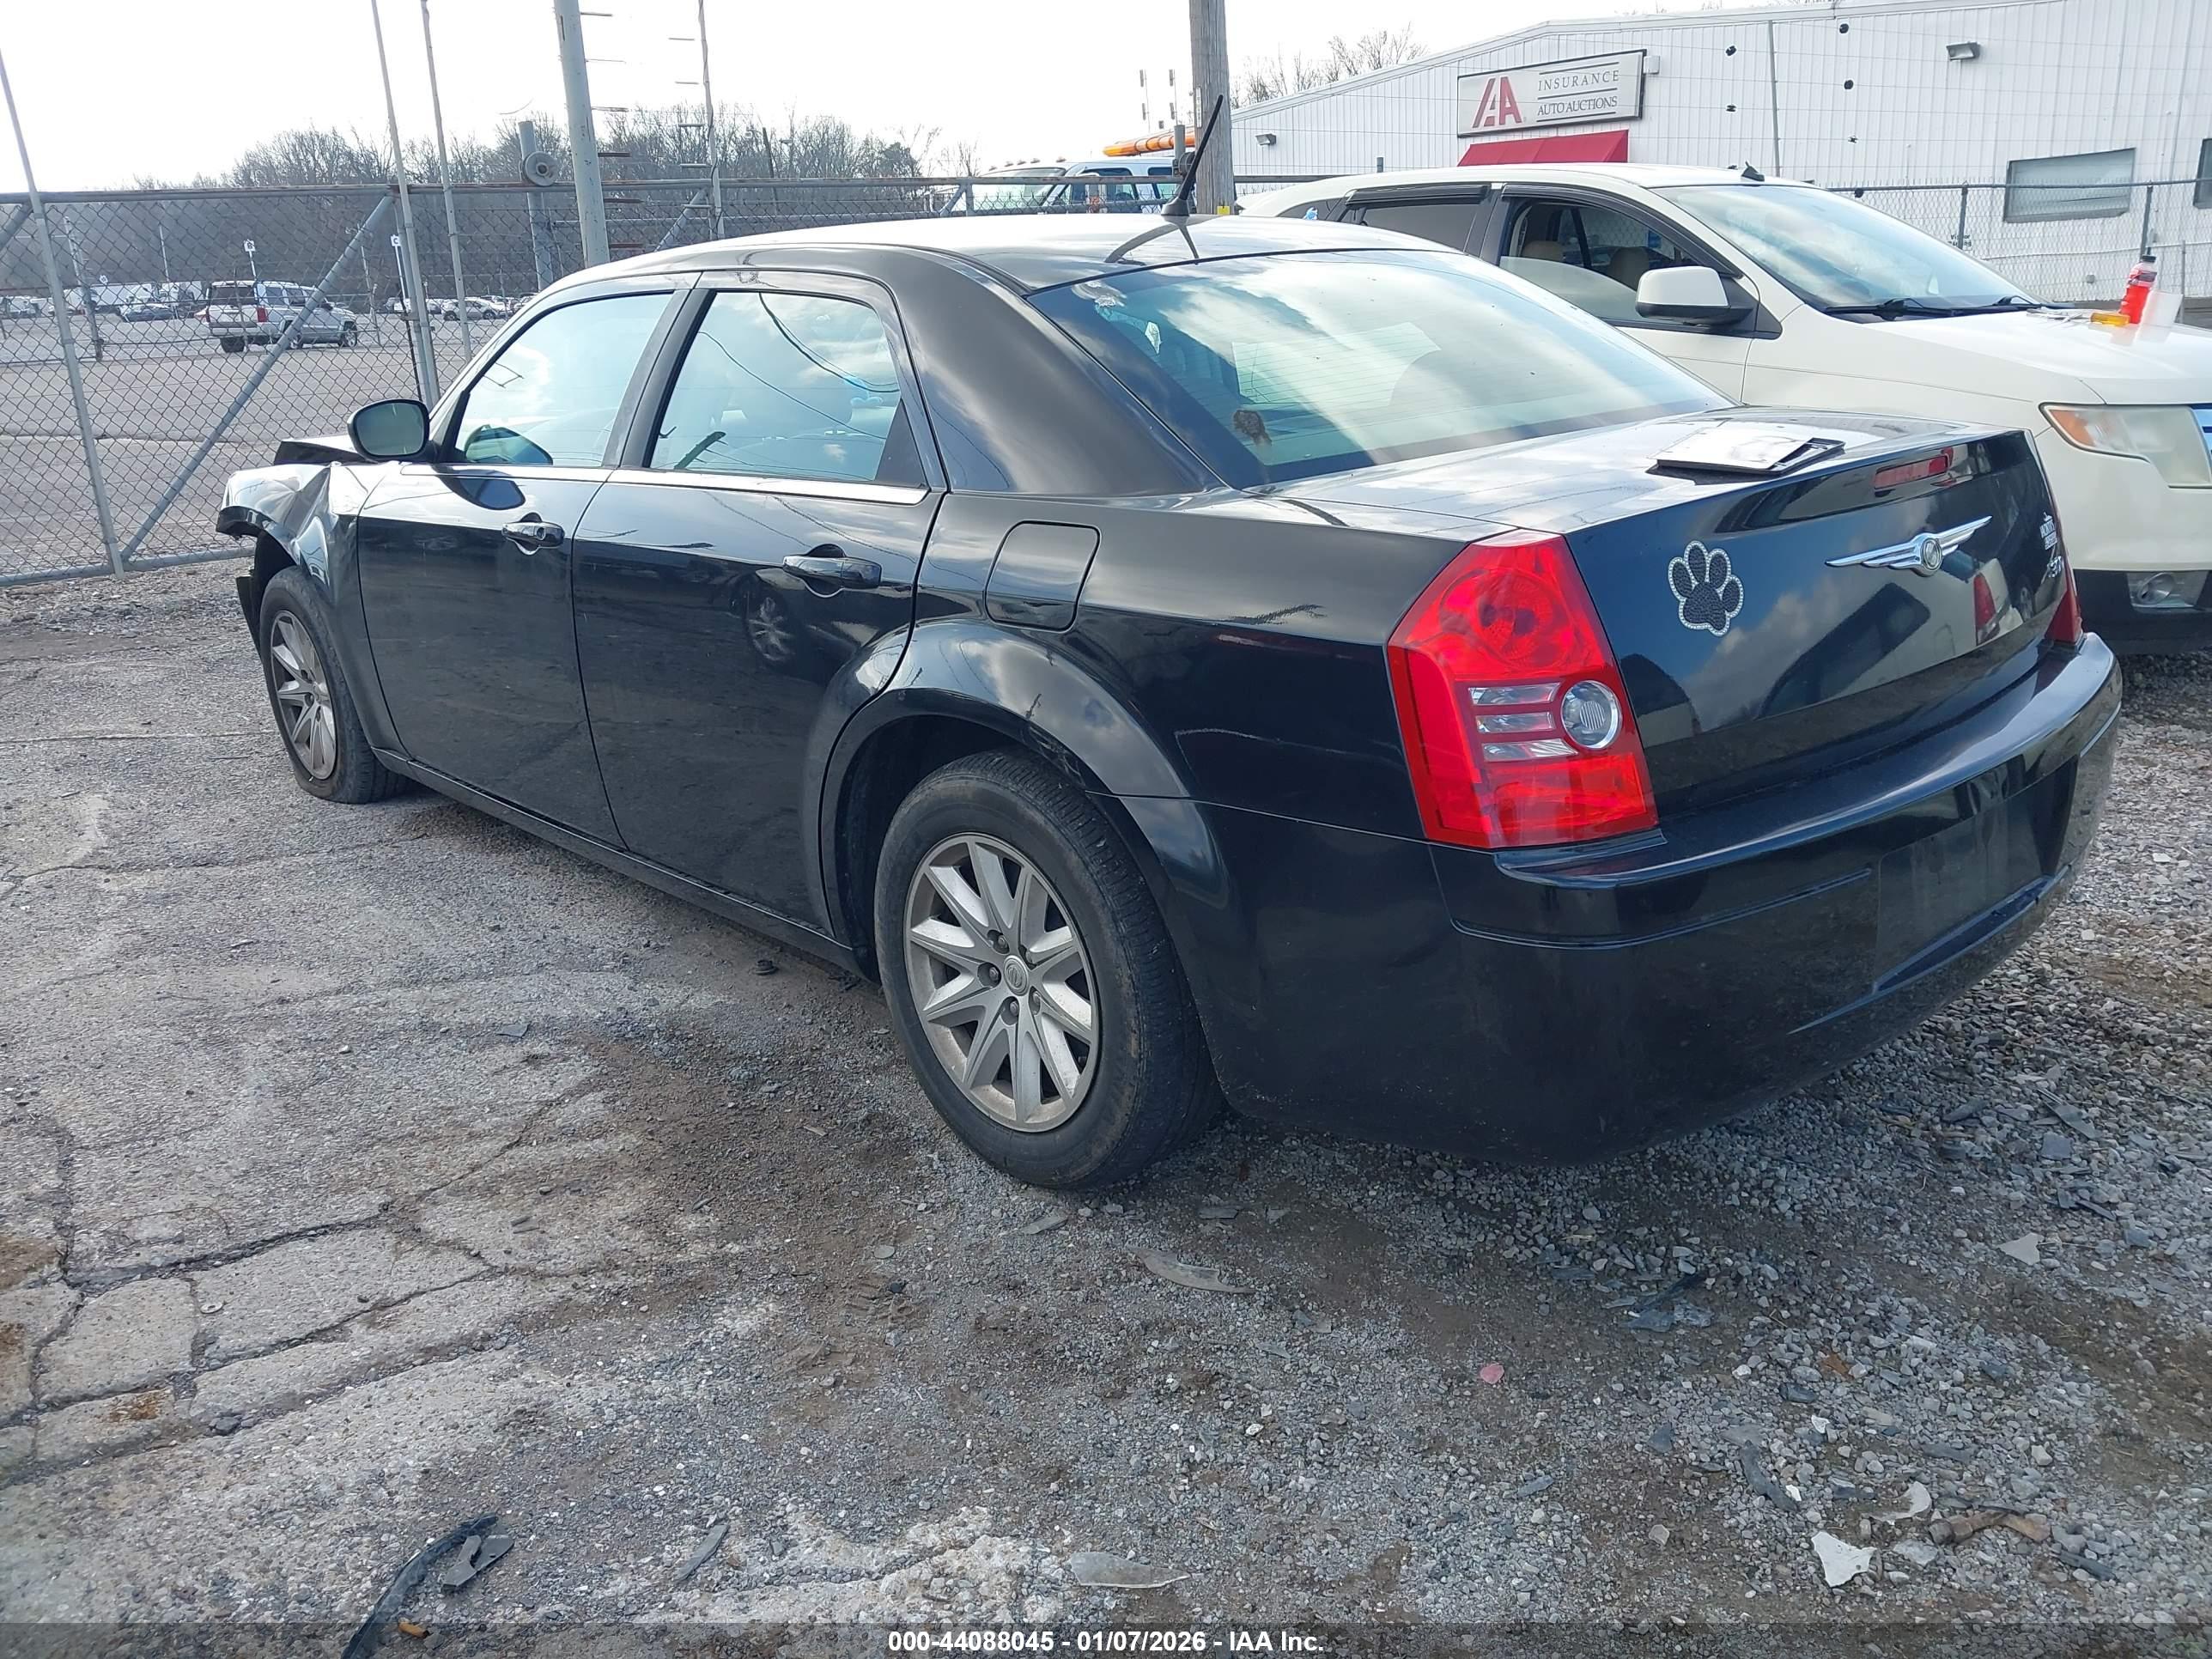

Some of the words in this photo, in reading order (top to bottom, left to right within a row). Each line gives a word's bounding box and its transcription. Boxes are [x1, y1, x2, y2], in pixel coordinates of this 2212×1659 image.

[1538, 70, 1620, 91] INSURANCE
[1538, 101, 1565, 116] AUTO
[1565, 96, 1618, 112] AUCTIONS
